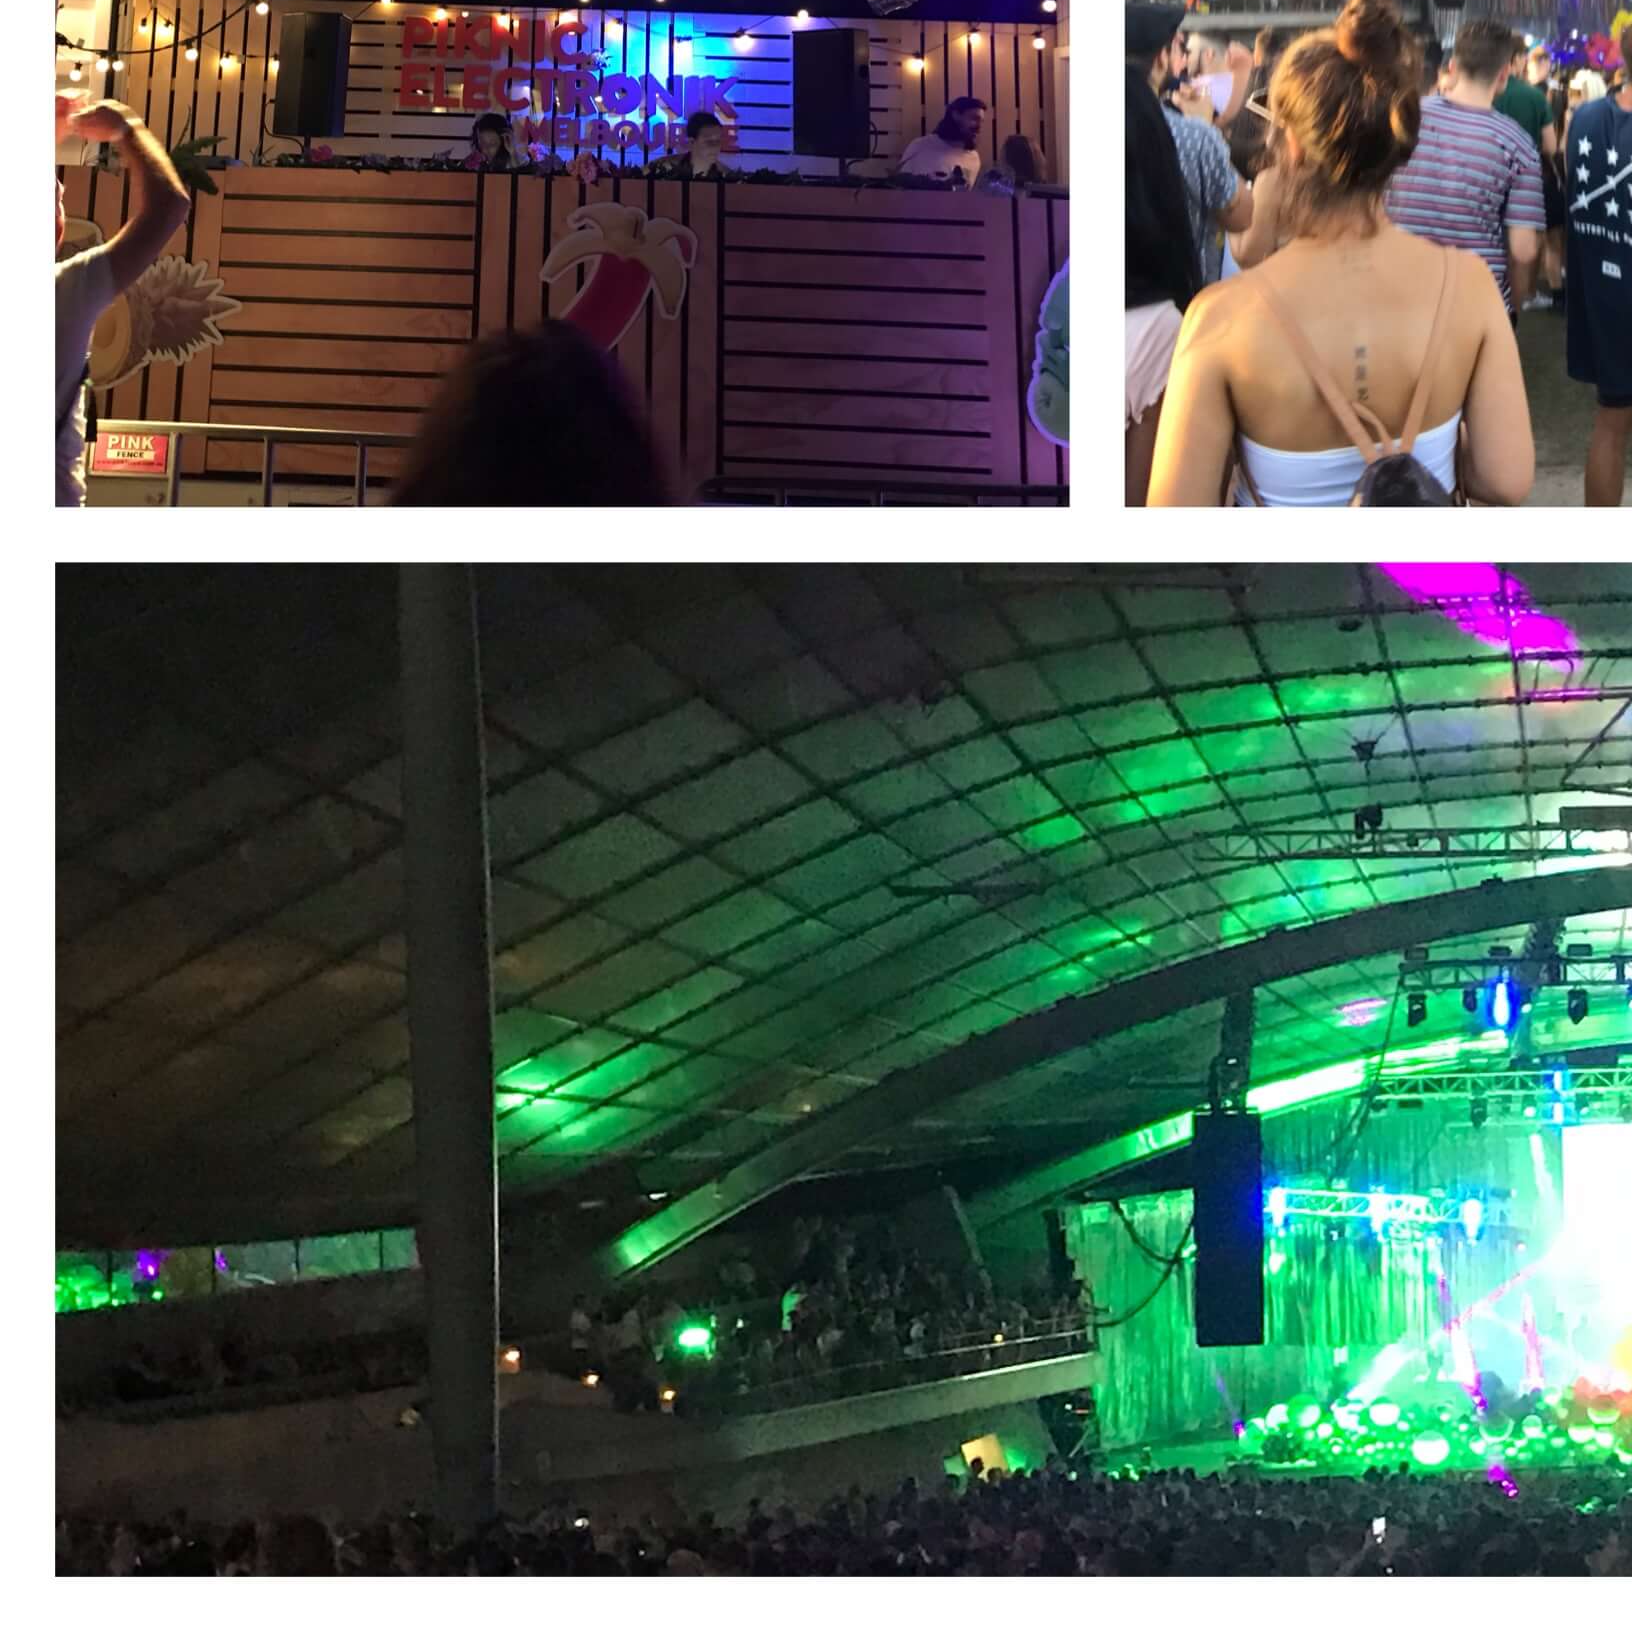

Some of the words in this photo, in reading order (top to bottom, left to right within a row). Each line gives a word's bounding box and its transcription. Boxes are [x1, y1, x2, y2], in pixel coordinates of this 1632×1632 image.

[400, 16, 592, 65] PIKNIC
[399, 64, 739, 119] ELECTRONIK
[523, 118, 740, 153] MELBOURE
[109, 435, 154, 449] PINK
